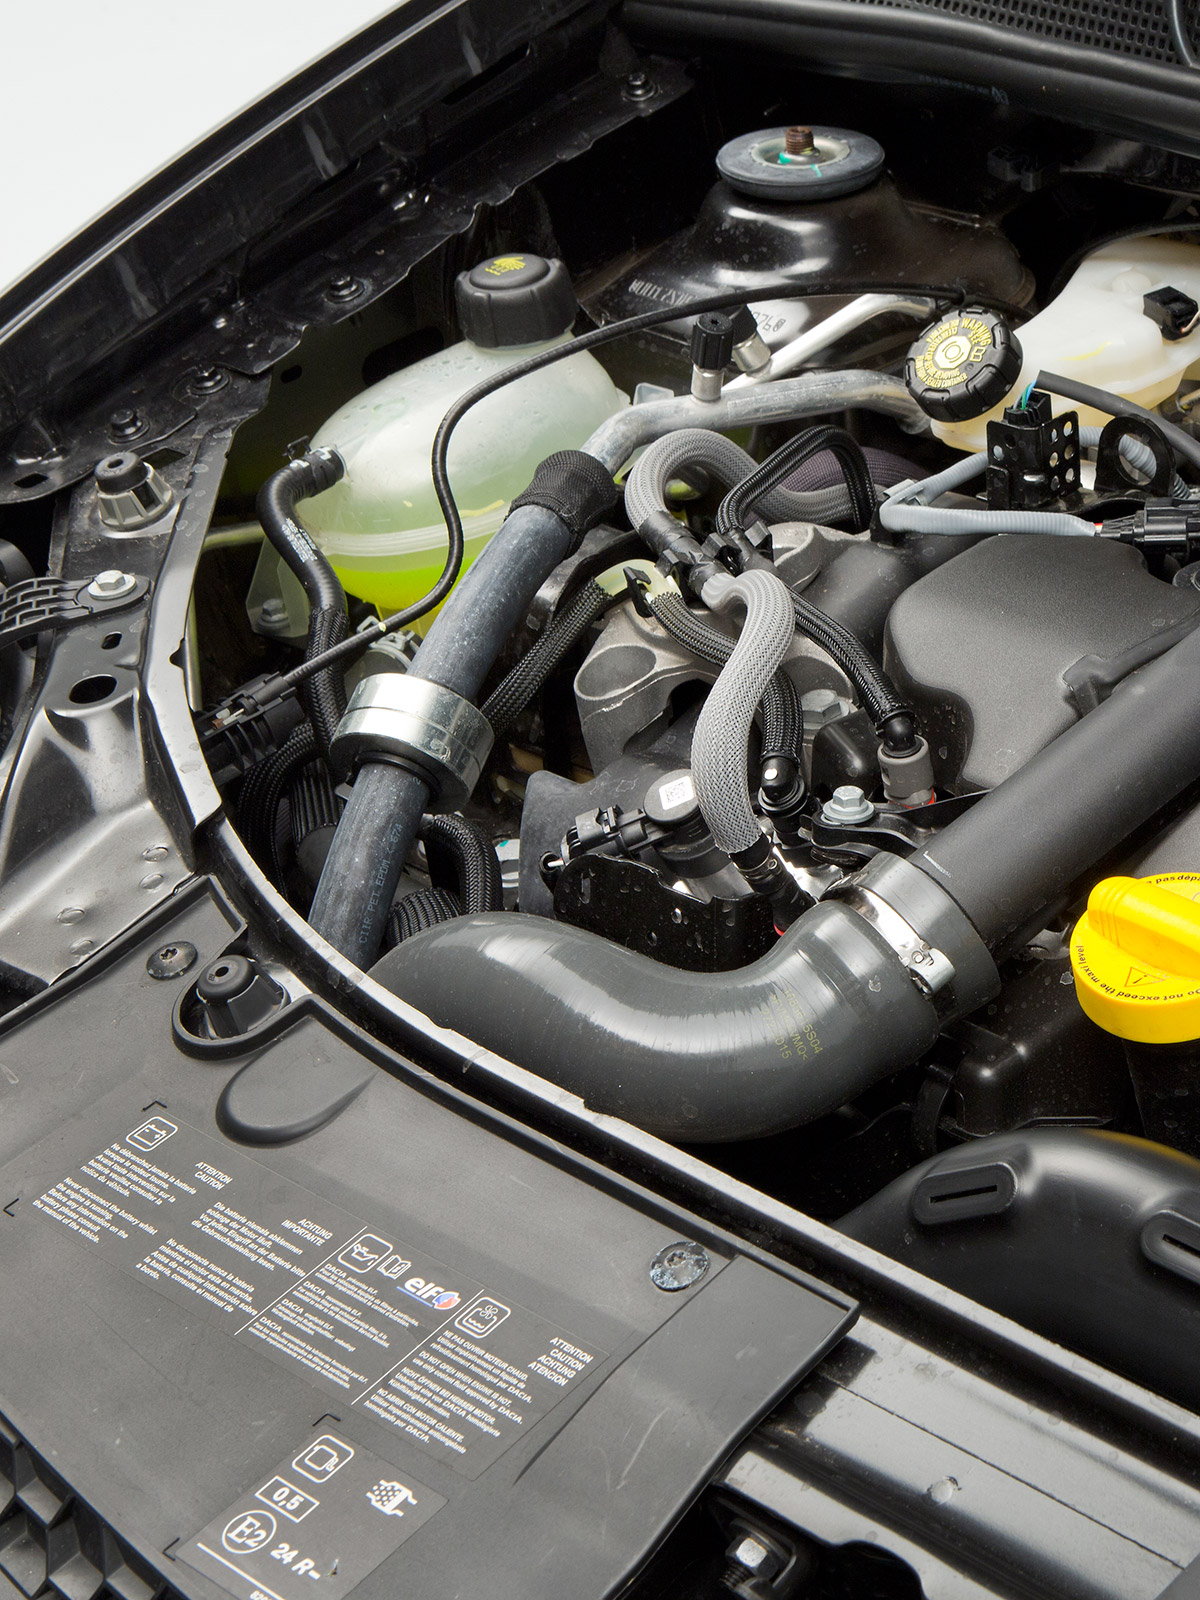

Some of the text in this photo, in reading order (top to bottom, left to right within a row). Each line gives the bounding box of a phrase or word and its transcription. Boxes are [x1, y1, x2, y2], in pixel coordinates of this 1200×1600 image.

[961, 317, 992, 346] WARNING
[368, 891, 381, 913] PET
[376, 859, 391, 887] EPDM
[1155, 876, 1176, 885] pas
[1076, 945, 1086, 965] level
[1084, 965, 1100, 984] maxi
[1100, 982, 1115, 995] the
[1118, 988, 1160, 1001] exceed
[1164, 993, 1184, 1002] not
[194, 1171, 224, 1190] CAUTION
[195, 1161, 232, 1183] ATTENTION
[281, 1219, 325, 1246] IMPORTANTE
[297, 1218, 332, 1239] ACHTUNG
[324, 1263, 346, 1278] DACIA
[302, 1280, 325, 1296] DACIA
[404, 1277, 444, 1300] elf
[281, 1298, 303, 1313] DACIA
[259, 1316, 281, 1332] DACIA
[549, 1337, 593, 1363] ATTENTION
[549, 1348, 585, 1370] CAUTION
[537, 1354, 576, 1378] ACHTUNG
[507, 1385, 531, 1403] DACIA.
[442, 1399, 466, 1417] DACIA
[497, 1405, 522, 1424] DACIA.
[404, 1424, 429, 1443] DACIA.
[272, 1486, 304, 1511] 0,5
[226, 1515, 267, 1548] E2
[270, 1542, 299, 1565] 24
